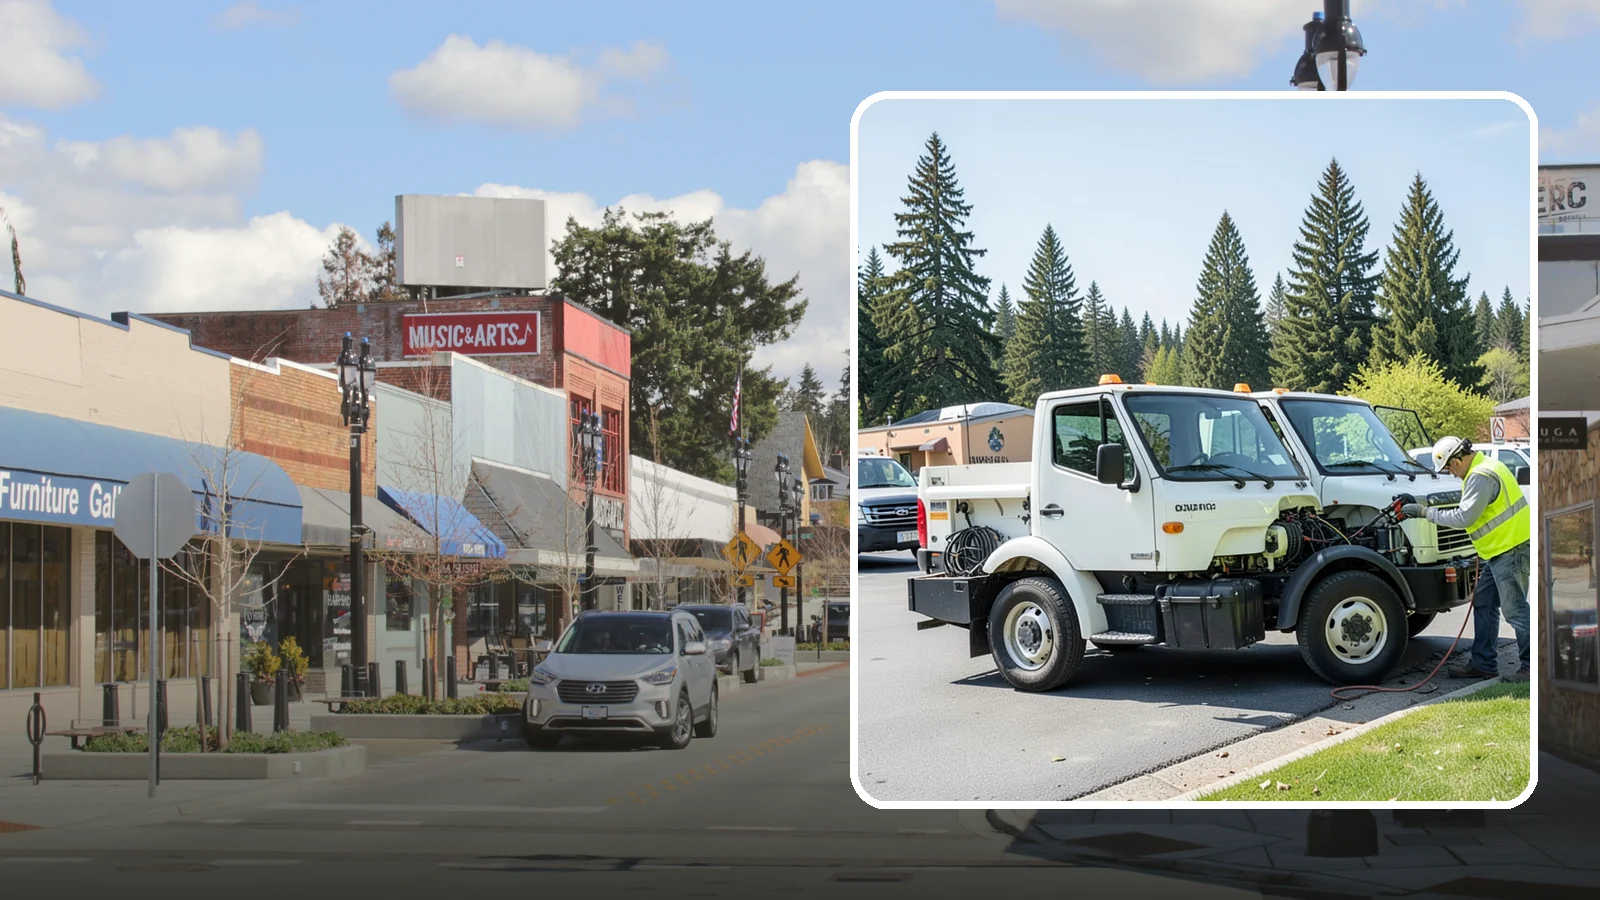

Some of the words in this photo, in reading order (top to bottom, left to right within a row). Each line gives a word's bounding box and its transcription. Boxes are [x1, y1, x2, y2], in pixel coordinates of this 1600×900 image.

[408, 323, 520, 349] MUSIC&ARTS
[0, 471, 79, 515] Furniture
[89, 482, 122, 519] Gal
